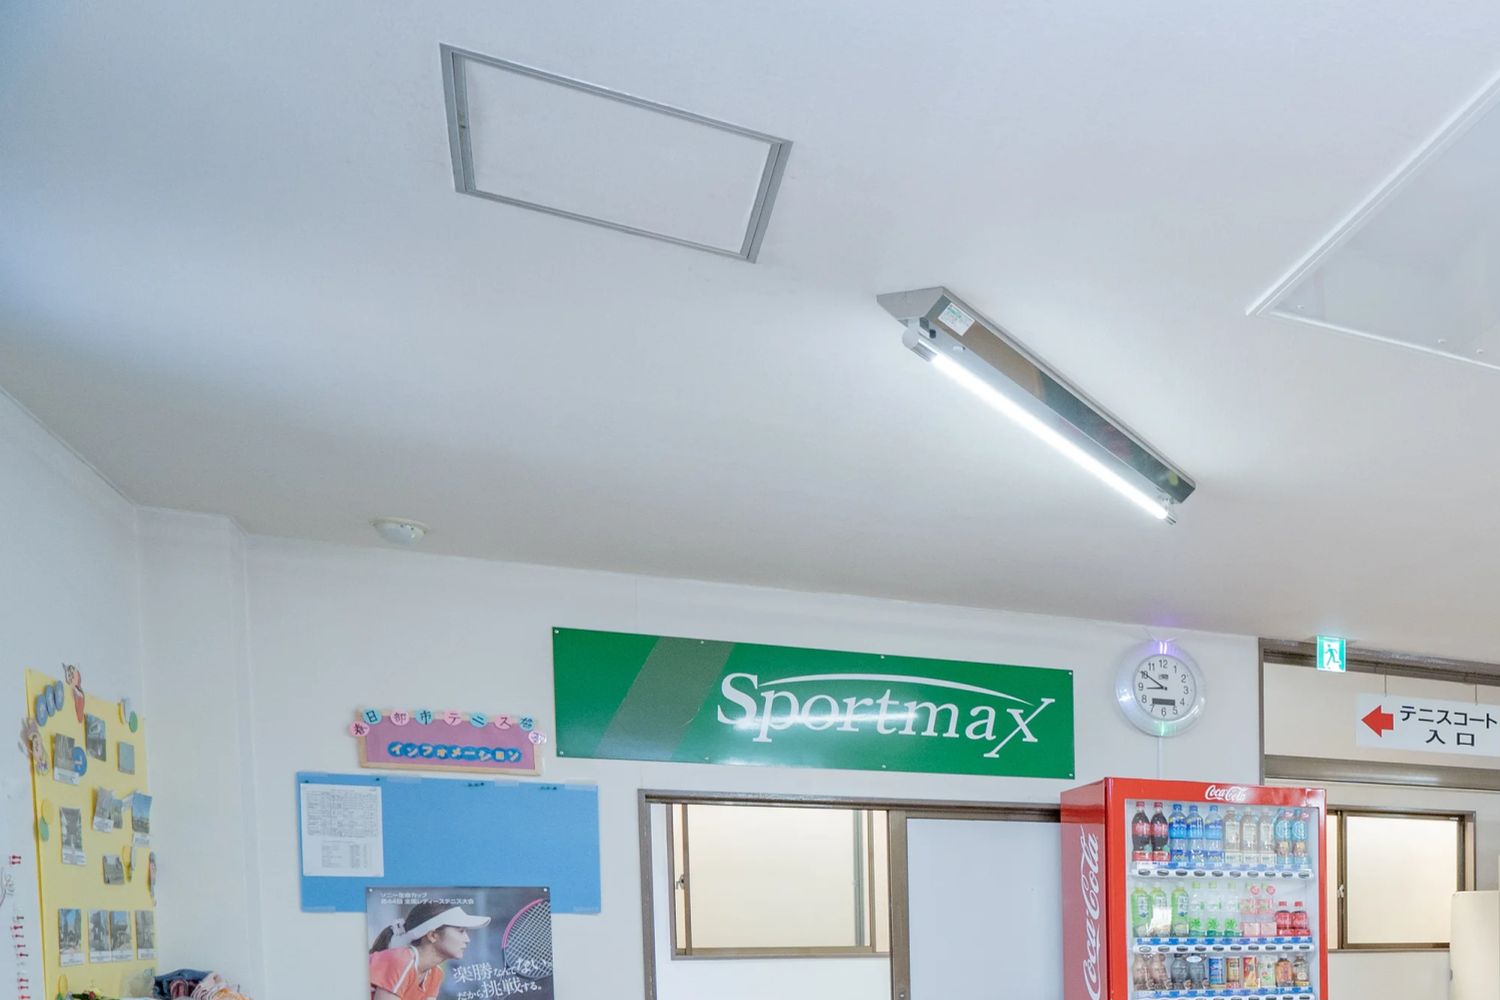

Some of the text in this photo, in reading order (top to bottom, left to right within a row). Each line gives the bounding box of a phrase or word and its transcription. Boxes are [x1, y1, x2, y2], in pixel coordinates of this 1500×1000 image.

[1148, 662, 1155, 671] 11
[1159, 659, 1168, 669] 12
[1181, 674, 1186, 683] 2
[1138, 682, 1144, 691] 9
[1183, 686, 1189, 695] 3
[1142, 694, 1147, 703] 8
[1180, 698, 1185, 706] 4
[717, 672, 1056, 758] Sportmax
[1161, 707, 1166, 717] 6
[1400, 705, 1498, 729] テニスコート
[1425, 728, 1475, 747] 入口
